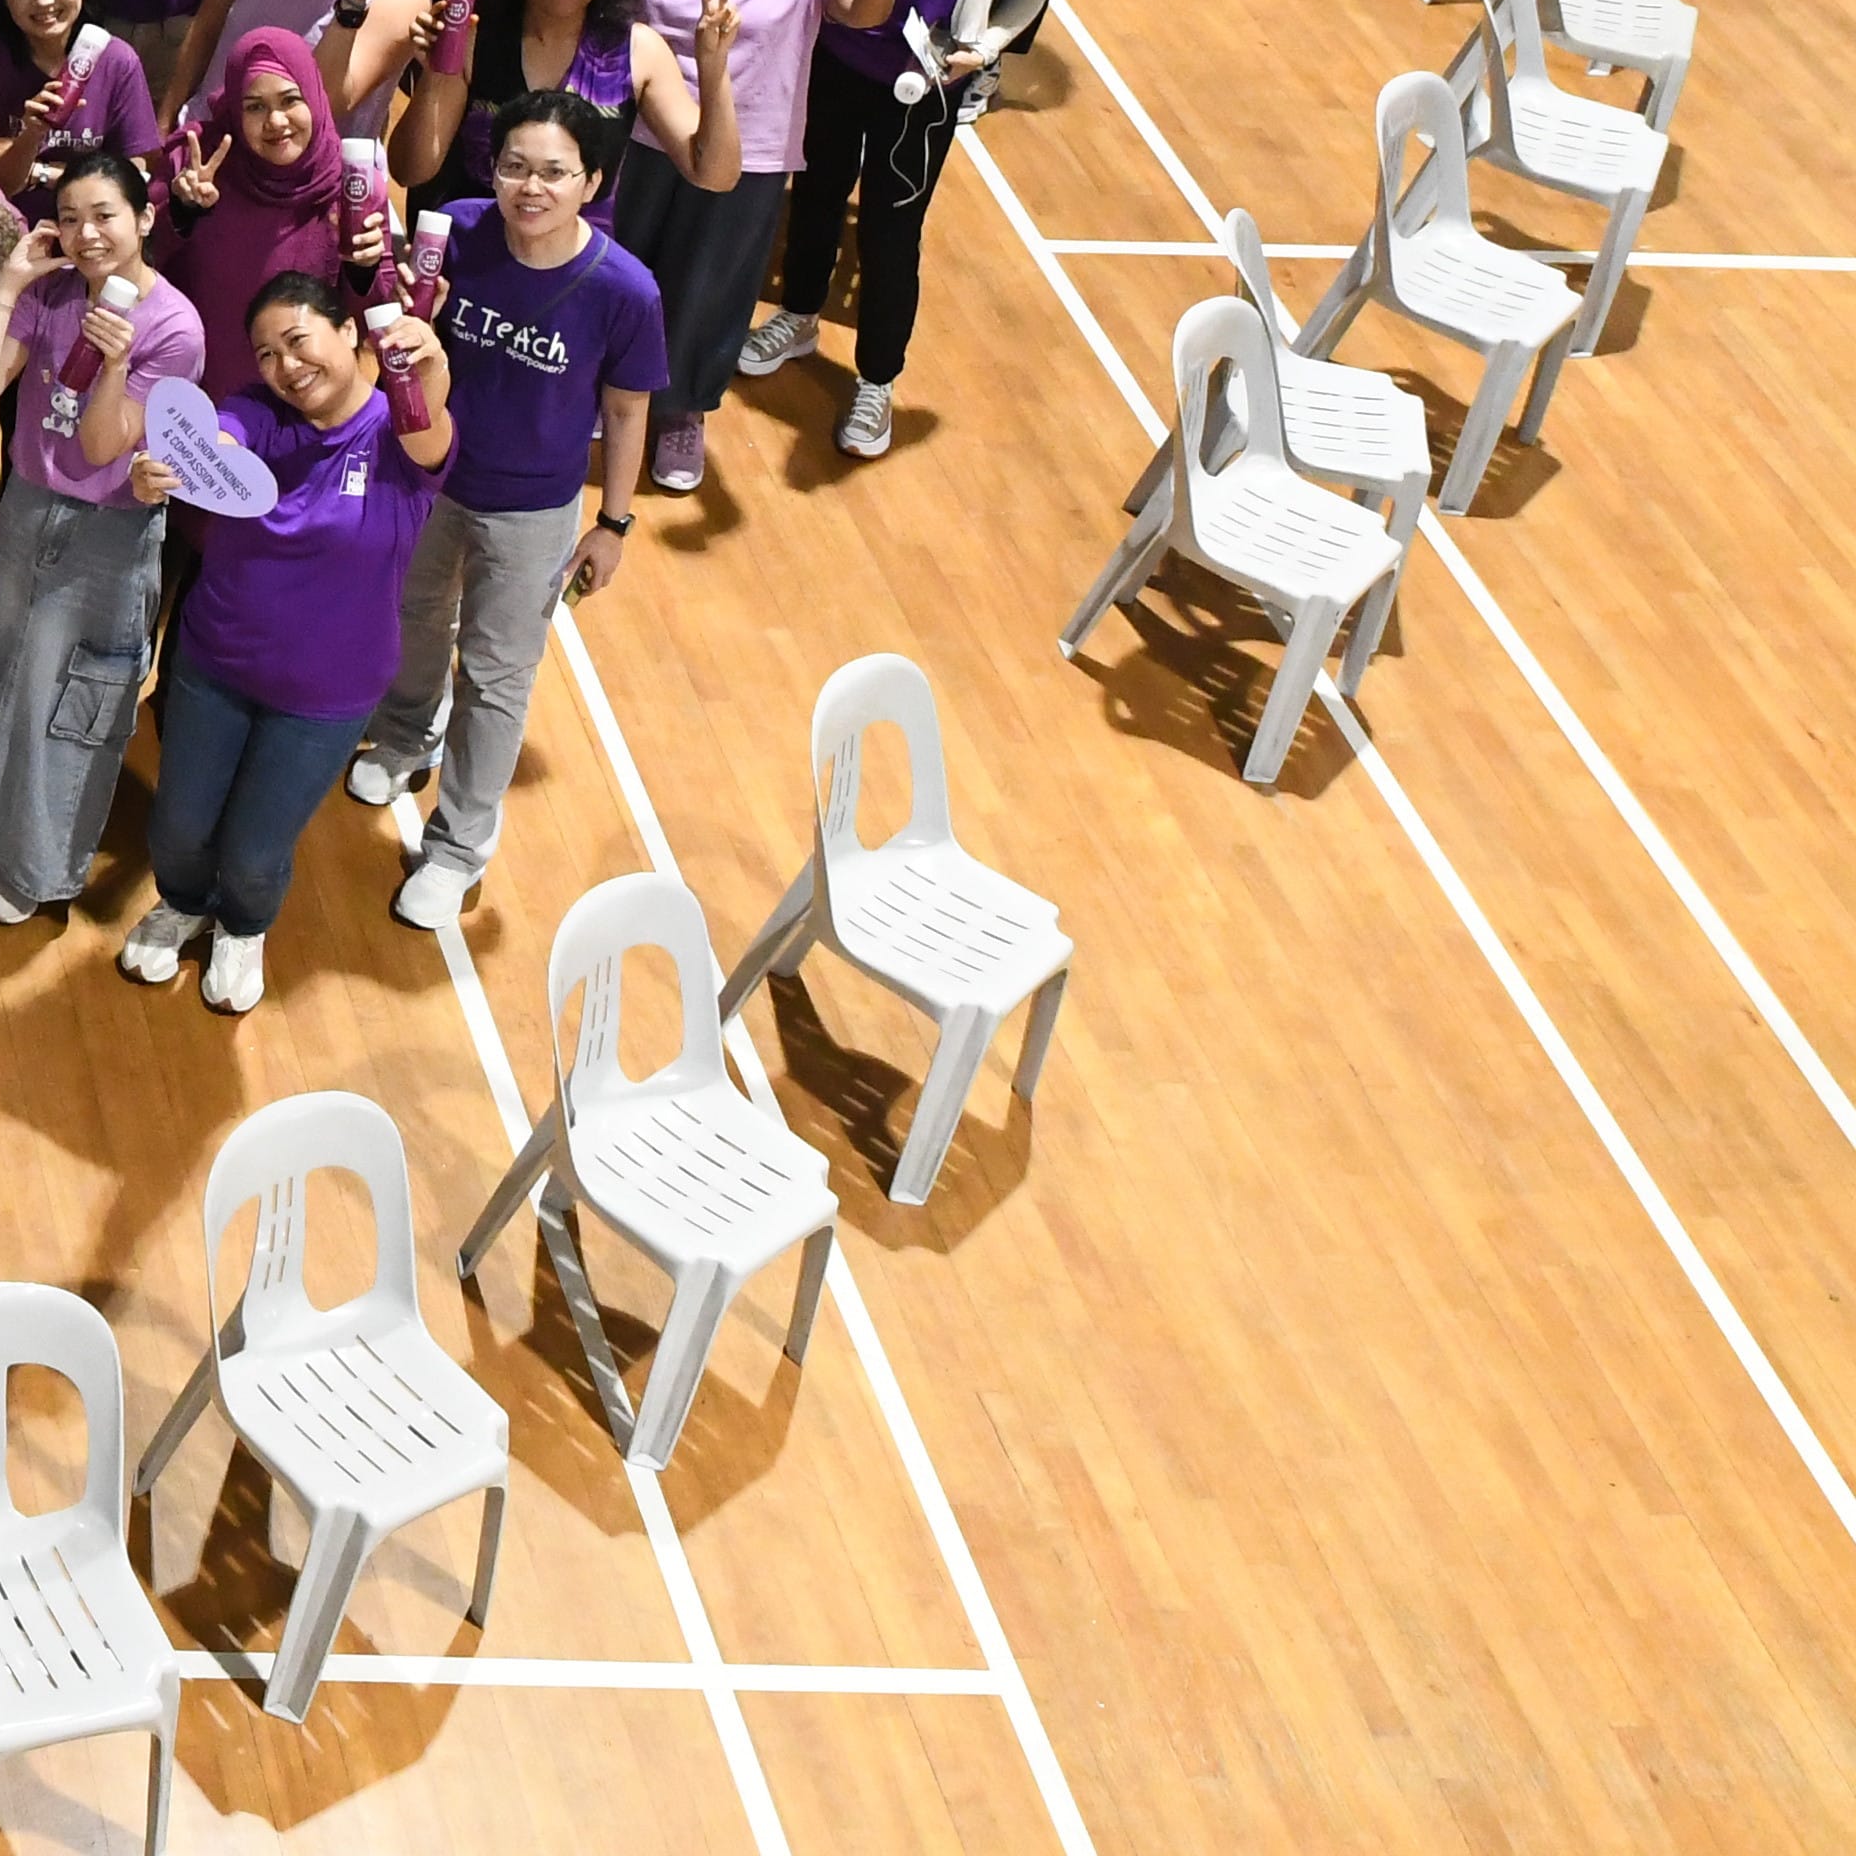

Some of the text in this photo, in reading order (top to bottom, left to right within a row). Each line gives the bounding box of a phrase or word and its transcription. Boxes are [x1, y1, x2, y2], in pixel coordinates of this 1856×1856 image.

[452, 298, 473, 327] I
[161, 428, 228, 501] & COMPASSION TO
[161, 453, 201, 497] EVERYONE
[177, 416, 198, 440] WILL
[193, 436, 220, 463] SHOW
[214, 459, 253, 502] KINDNESS
